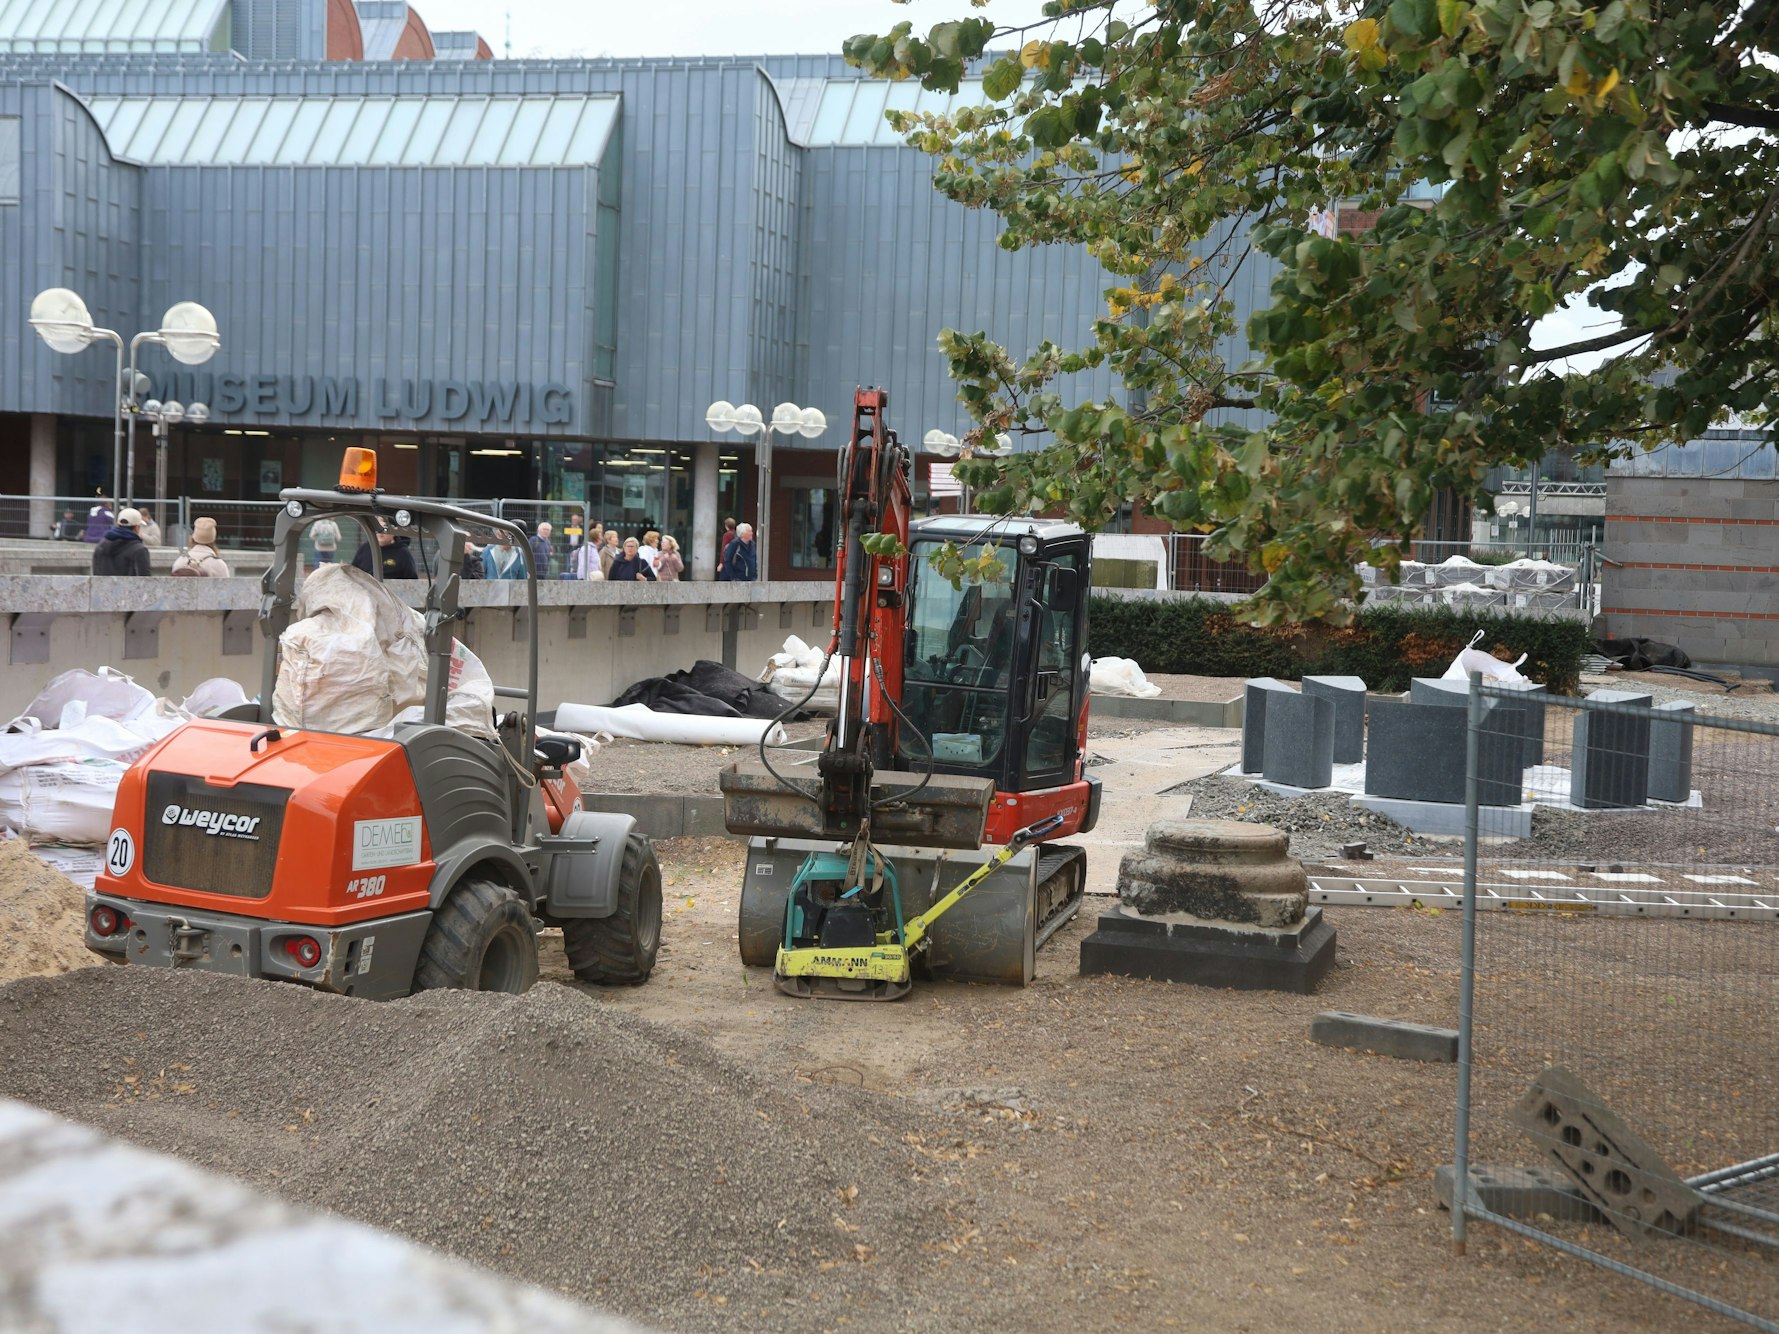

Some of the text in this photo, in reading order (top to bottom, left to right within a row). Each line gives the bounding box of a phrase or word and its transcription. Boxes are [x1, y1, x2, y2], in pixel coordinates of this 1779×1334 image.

[146, 371, 572, 424] MUSEUM LUDWIG
[178, 808, 260, 835] weycor
[111, 836, 128, 868] 20
[346, 875, 386, 899] AR 380
